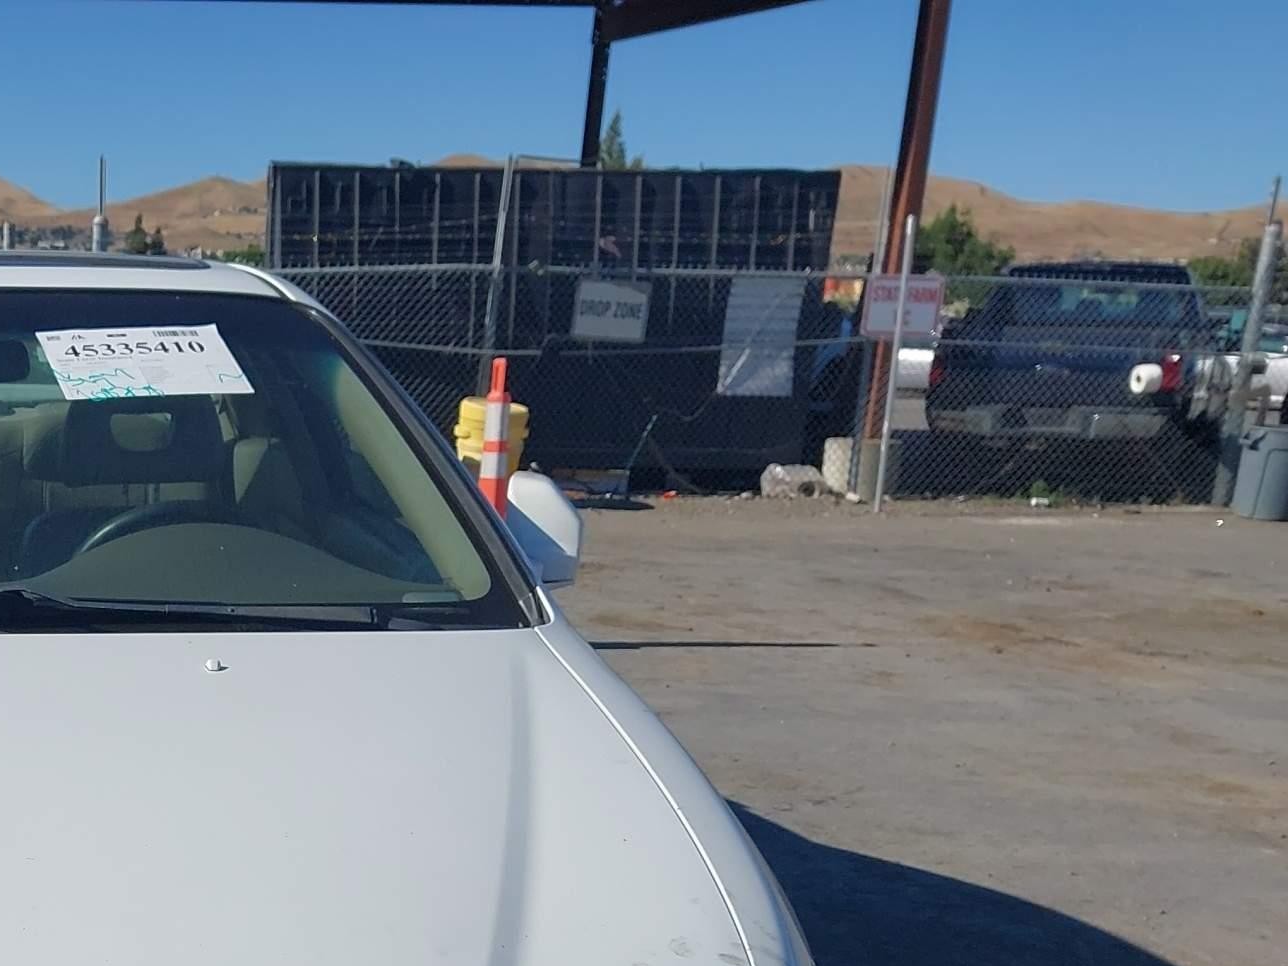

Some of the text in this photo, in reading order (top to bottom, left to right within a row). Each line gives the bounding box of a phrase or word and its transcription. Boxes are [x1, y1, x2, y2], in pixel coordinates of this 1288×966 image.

[580, 299, 643, 319] DROP ZONE
[64, 340, 205, 358] 45335410
